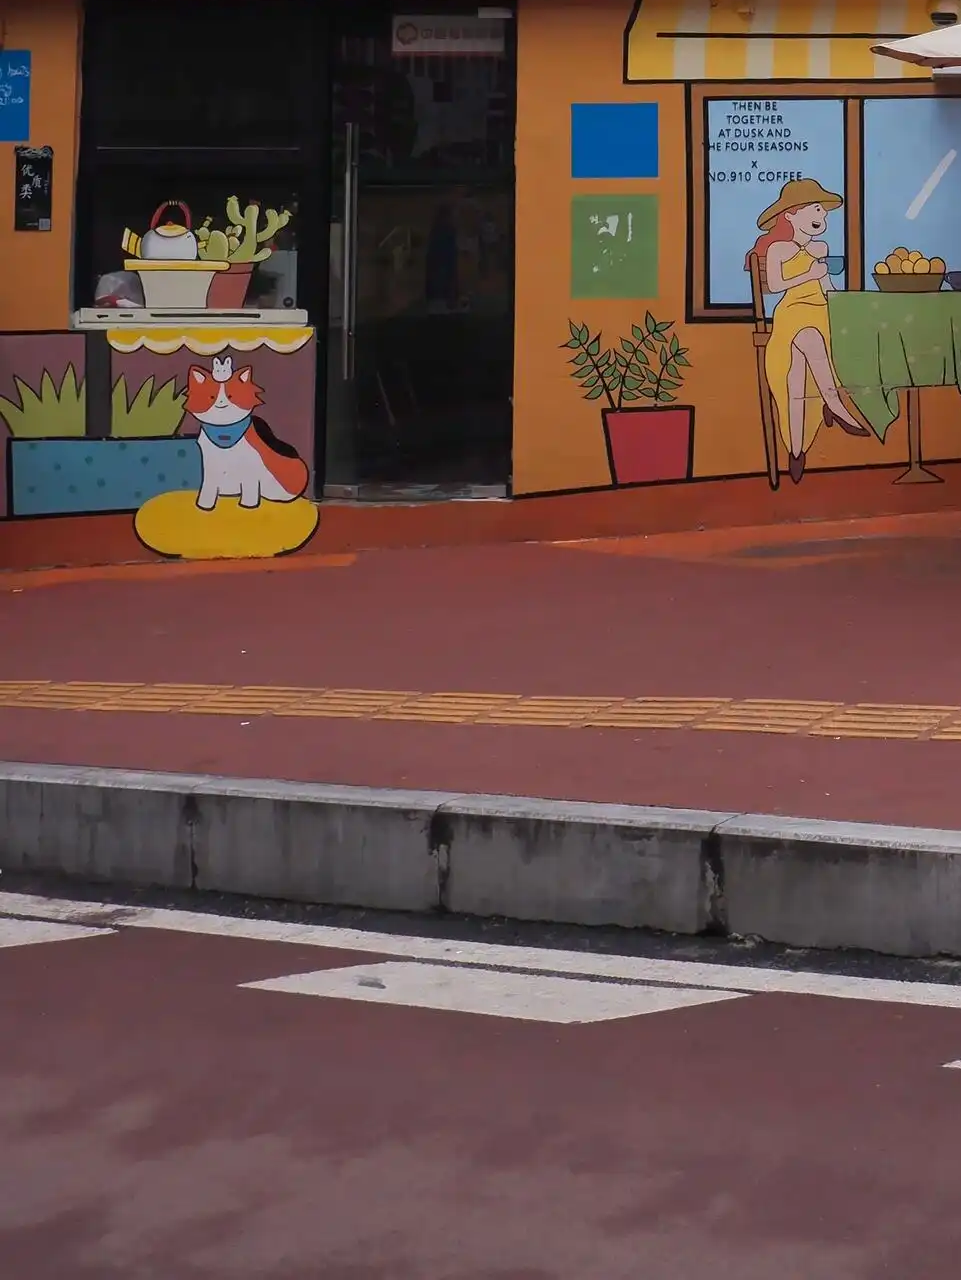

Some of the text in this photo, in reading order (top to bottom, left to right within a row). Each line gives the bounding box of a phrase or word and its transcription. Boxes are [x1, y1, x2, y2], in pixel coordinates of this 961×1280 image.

[732, 101, 778, 111] THEN BE
[726, 114, 783, 125] TOGETHER
[718, 128, 791, 138] AT DUSK AND
[705, 141, 809, 152] HE FOUR SEASONS
[708, 171, 803, 182] NO.910 COFFEE
